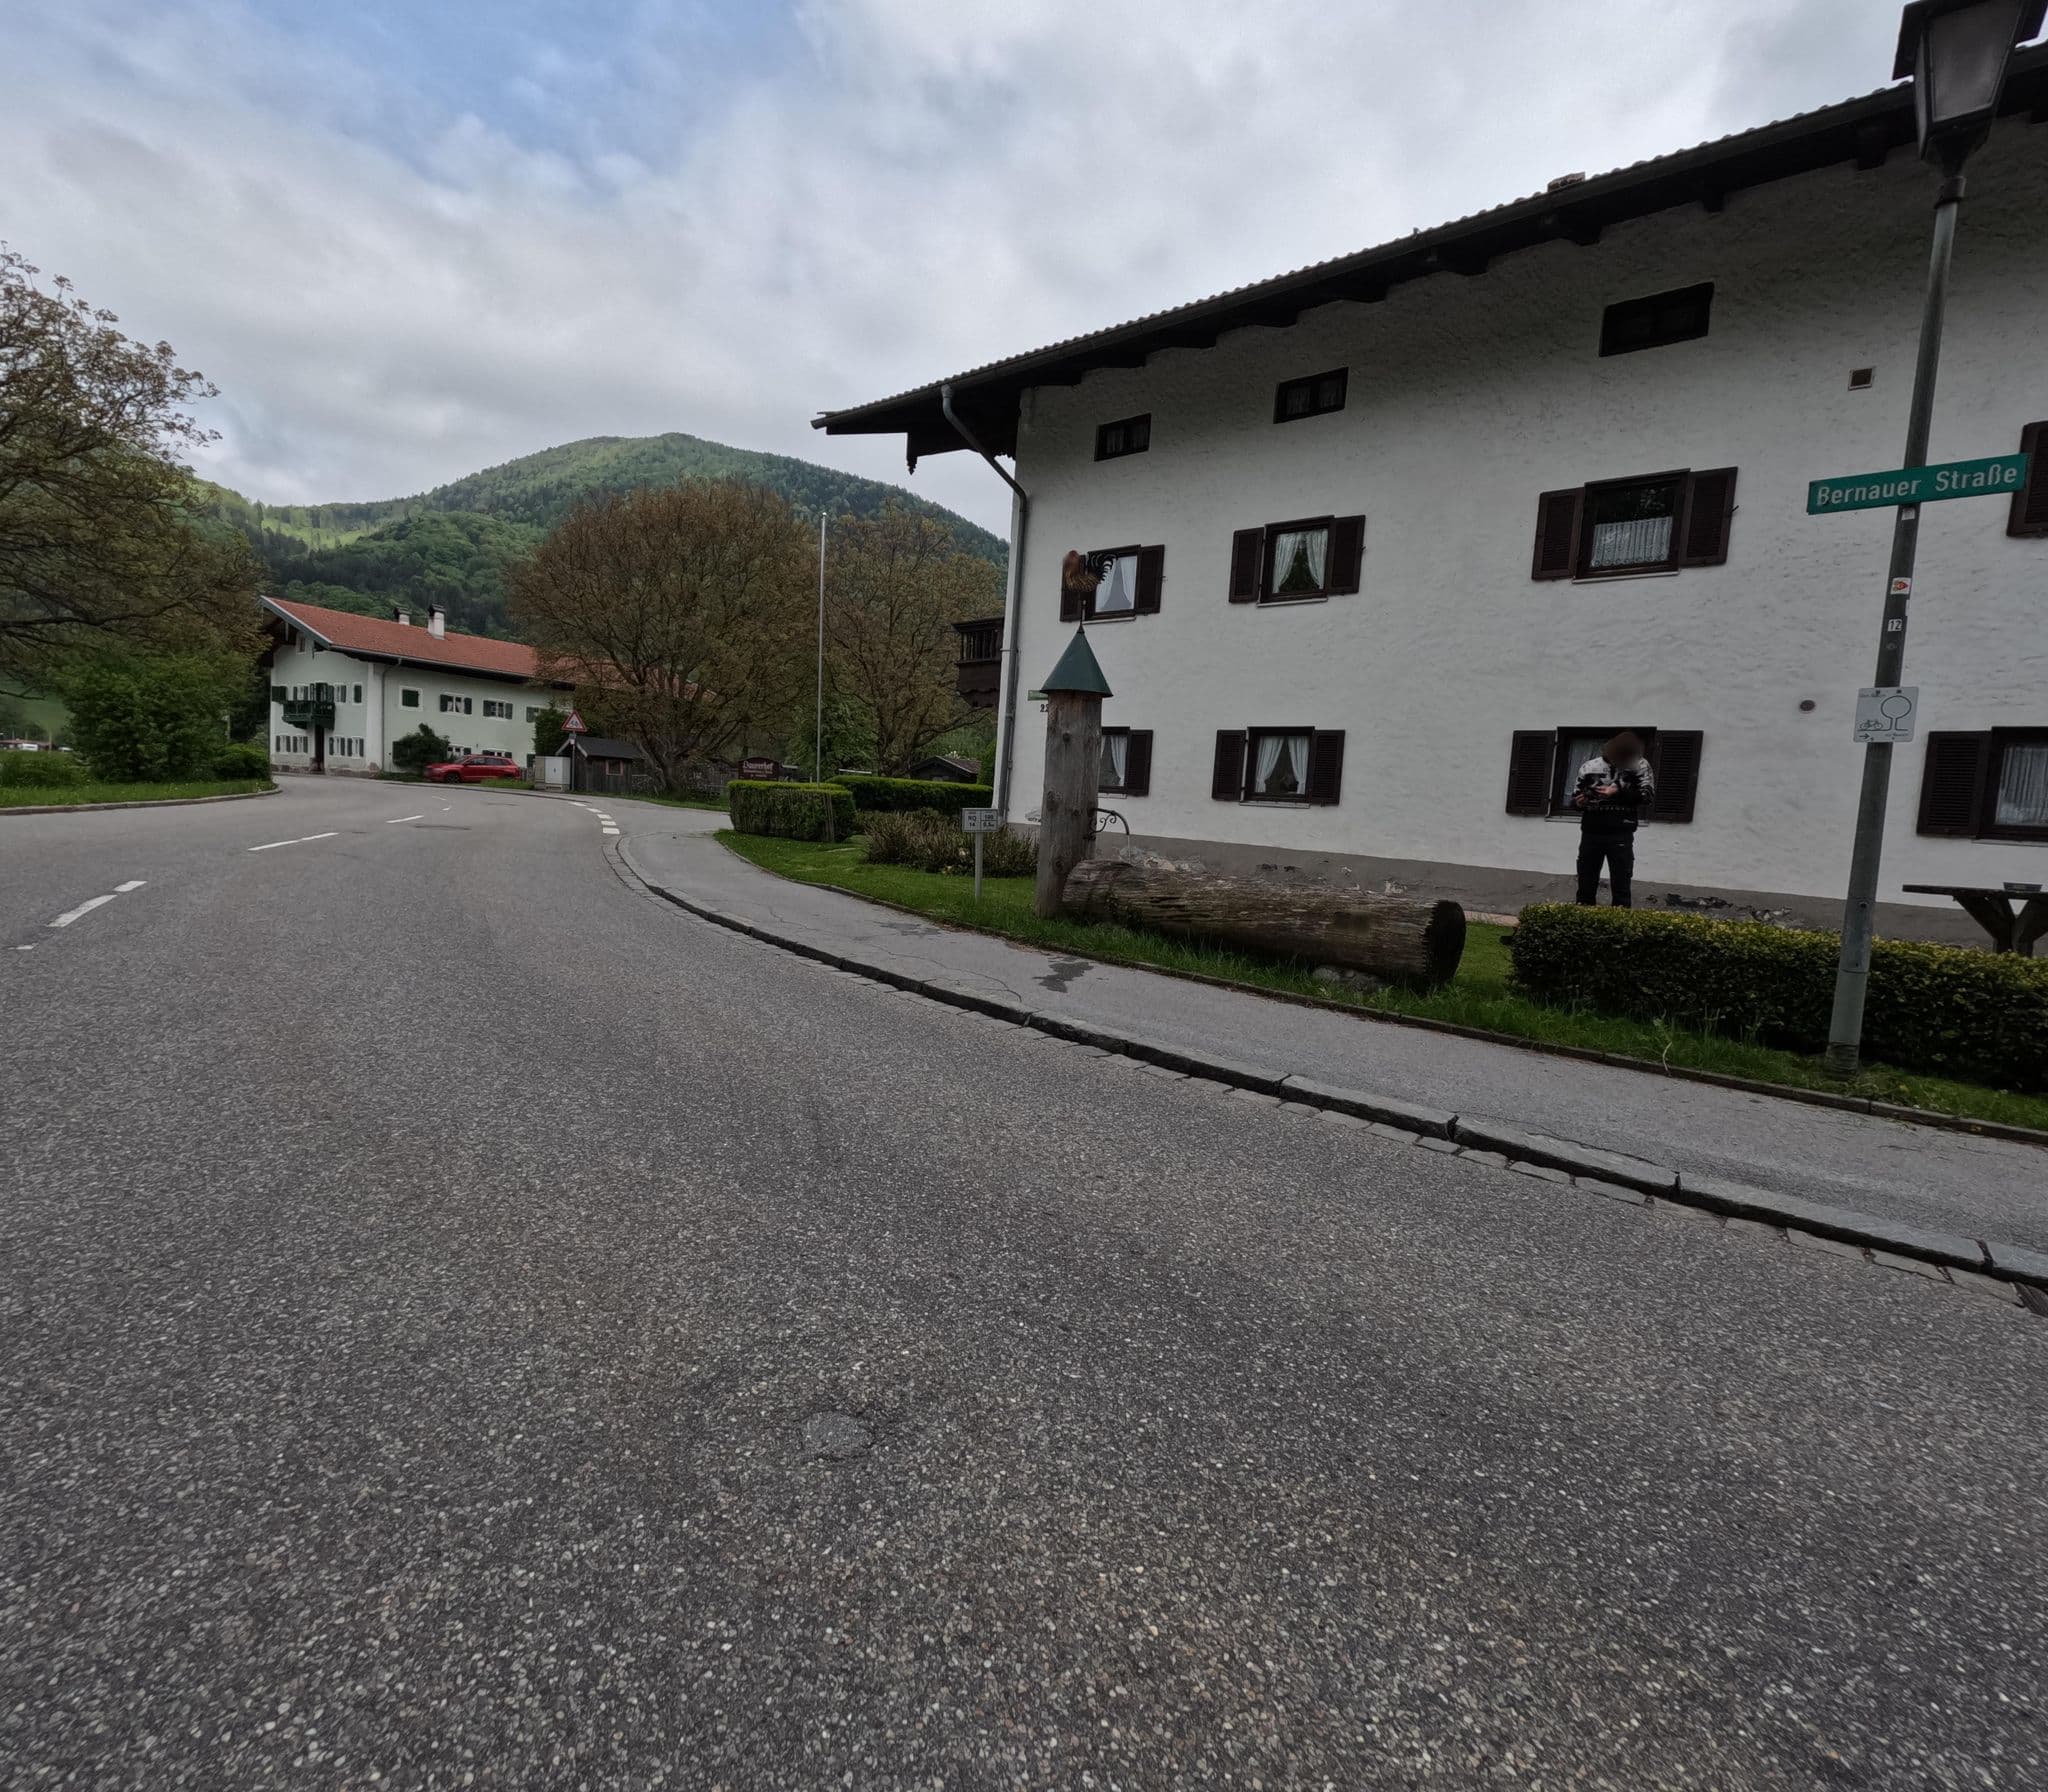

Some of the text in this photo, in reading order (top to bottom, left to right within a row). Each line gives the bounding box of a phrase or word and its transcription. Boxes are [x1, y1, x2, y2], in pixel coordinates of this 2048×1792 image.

[1816, 464, 2017, 505] Bernauer Straße
[1890, 620, 1901, 630] 12
